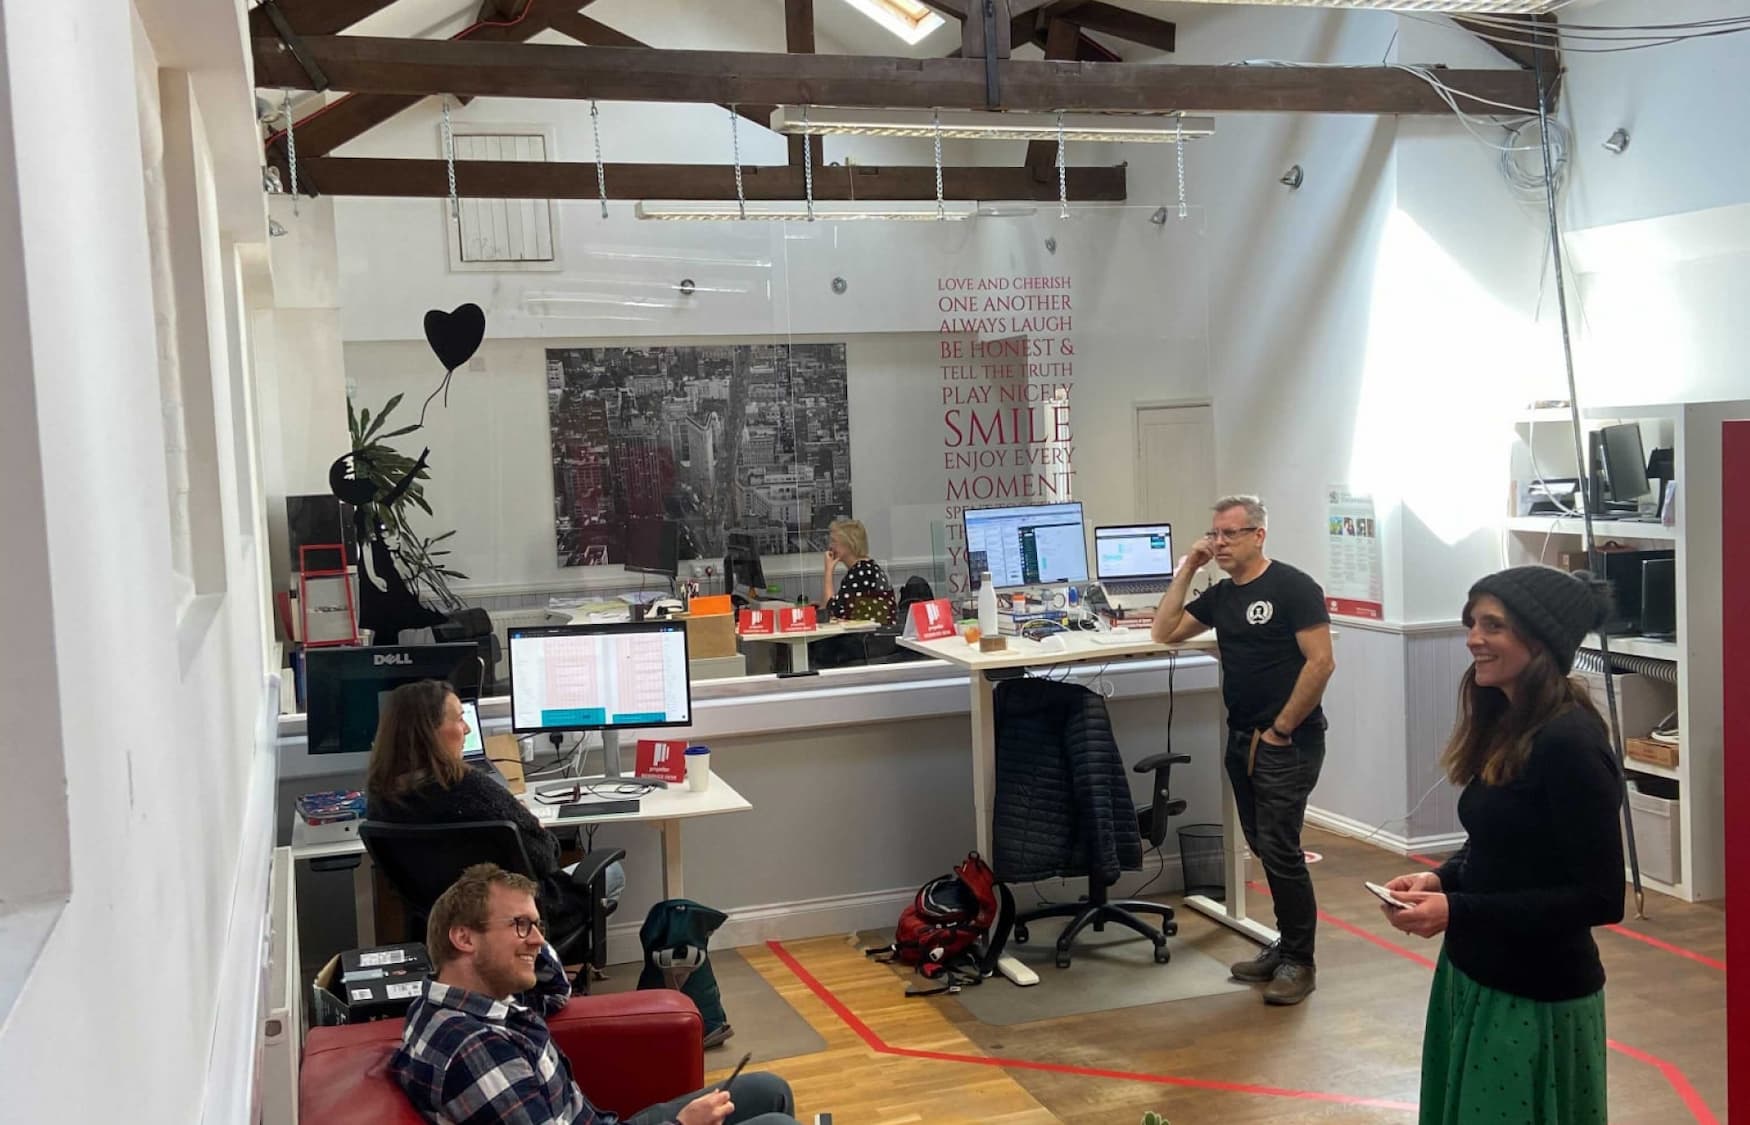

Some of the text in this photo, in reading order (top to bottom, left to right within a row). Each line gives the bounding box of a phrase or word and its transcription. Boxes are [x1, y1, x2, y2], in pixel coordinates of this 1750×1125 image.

[938, 276, 1072, 291] LOVE AND CHERISH
[938, 294, 1072, 313] ONE ANOTHER
[940, 315, 1072, 334] ALWAYS LAUGH
[940, 337, 1075, 359] BE HONEST &
[940, 362, 1073, 380] TELL THE TRUTH
[942, 384, 1074, 405] PLAY NICELY
[944, 407, 1073, 448] SMILE
[944, 447, 1077, 472] ENJOY EVERY
[946, 471, 1077, 501] MOMENT
[373, 653, 414, 666] DELL
